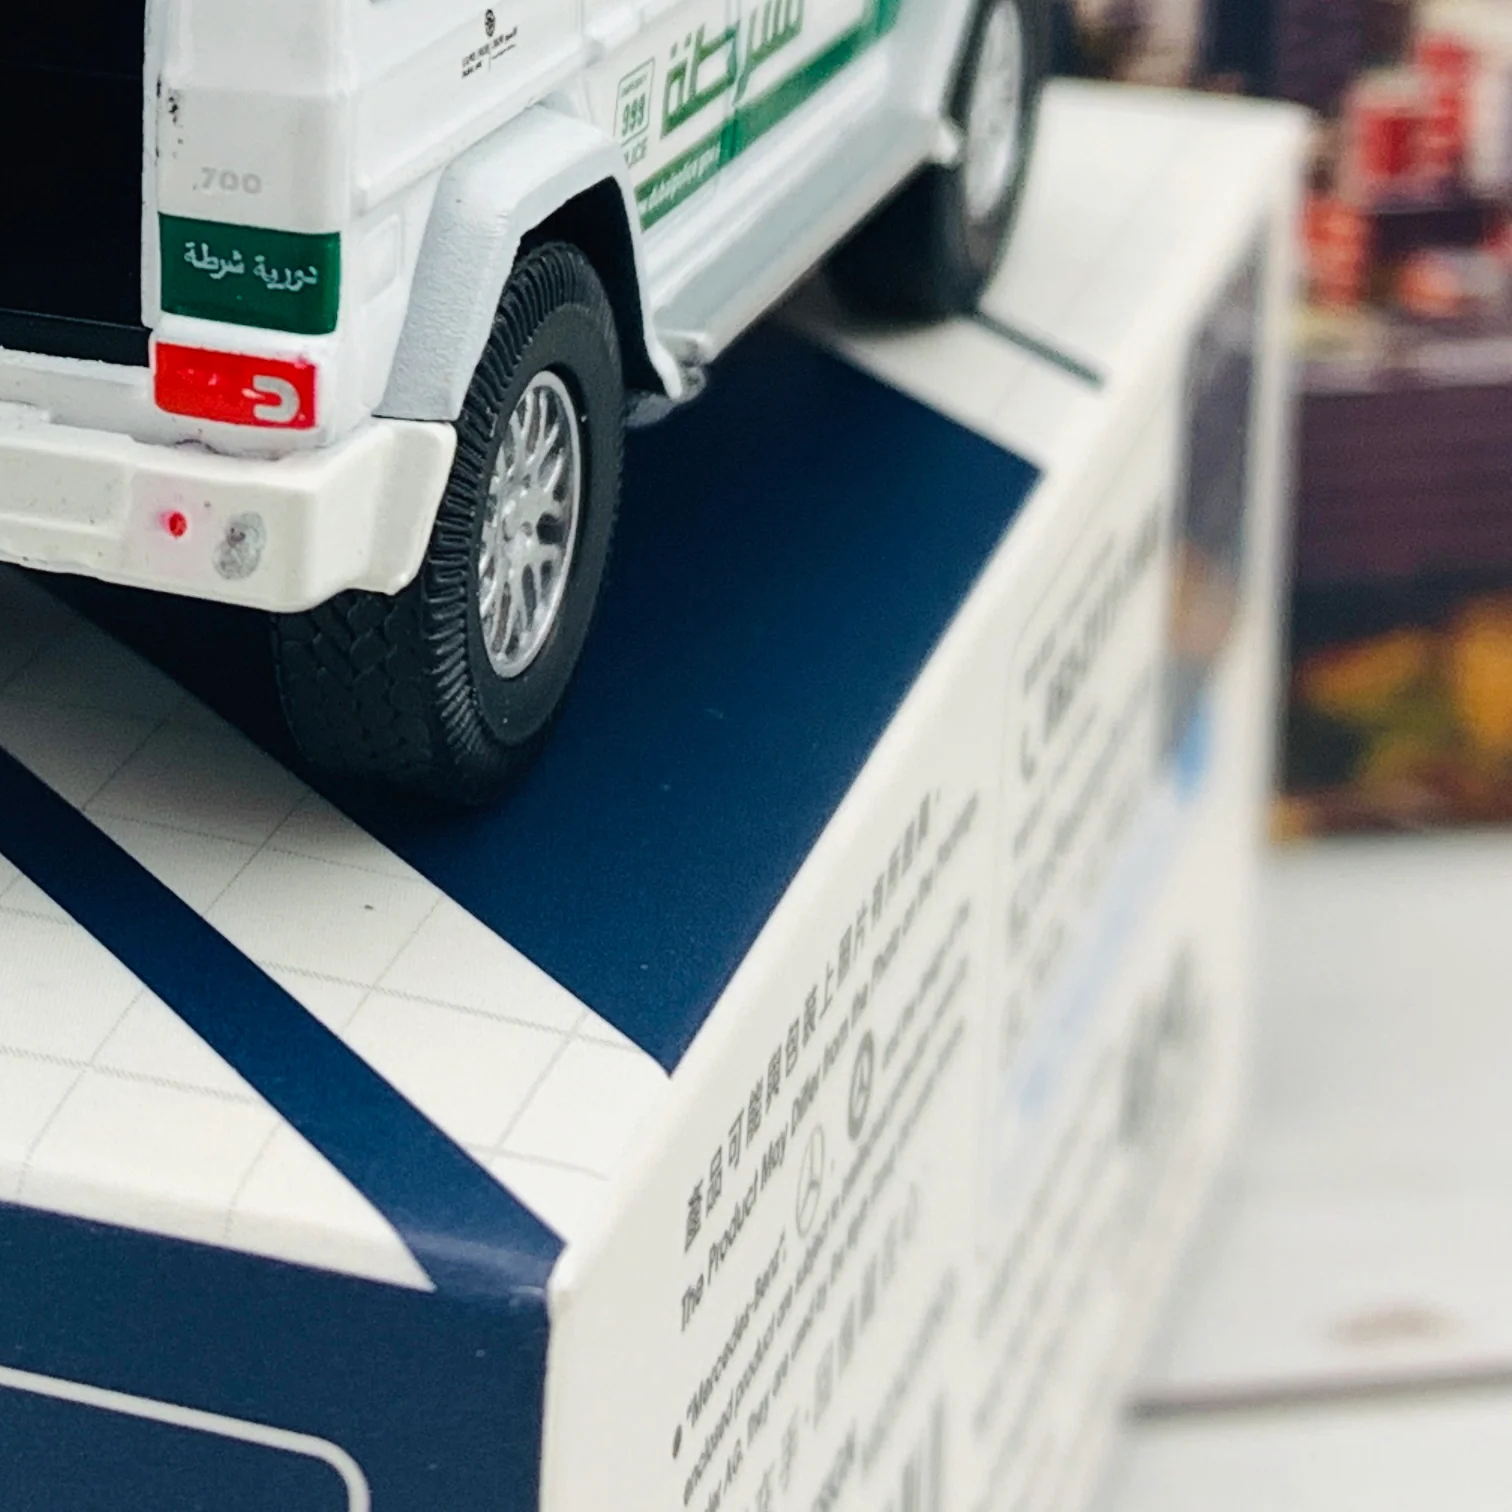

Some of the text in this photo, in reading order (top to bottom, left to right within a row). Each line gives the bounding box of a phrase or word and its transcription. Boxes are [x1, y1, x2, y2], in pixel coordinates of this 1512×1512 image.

[183, 241, 246, 280] شرطة
[681, 1273, 704, 1332] The
[707, 1168, 758, 1286] Product
[760, 1131, 788, 1191] May
[683, 1390, 734, 1506] enclosed
[735, 1309, 776, 1419] product
